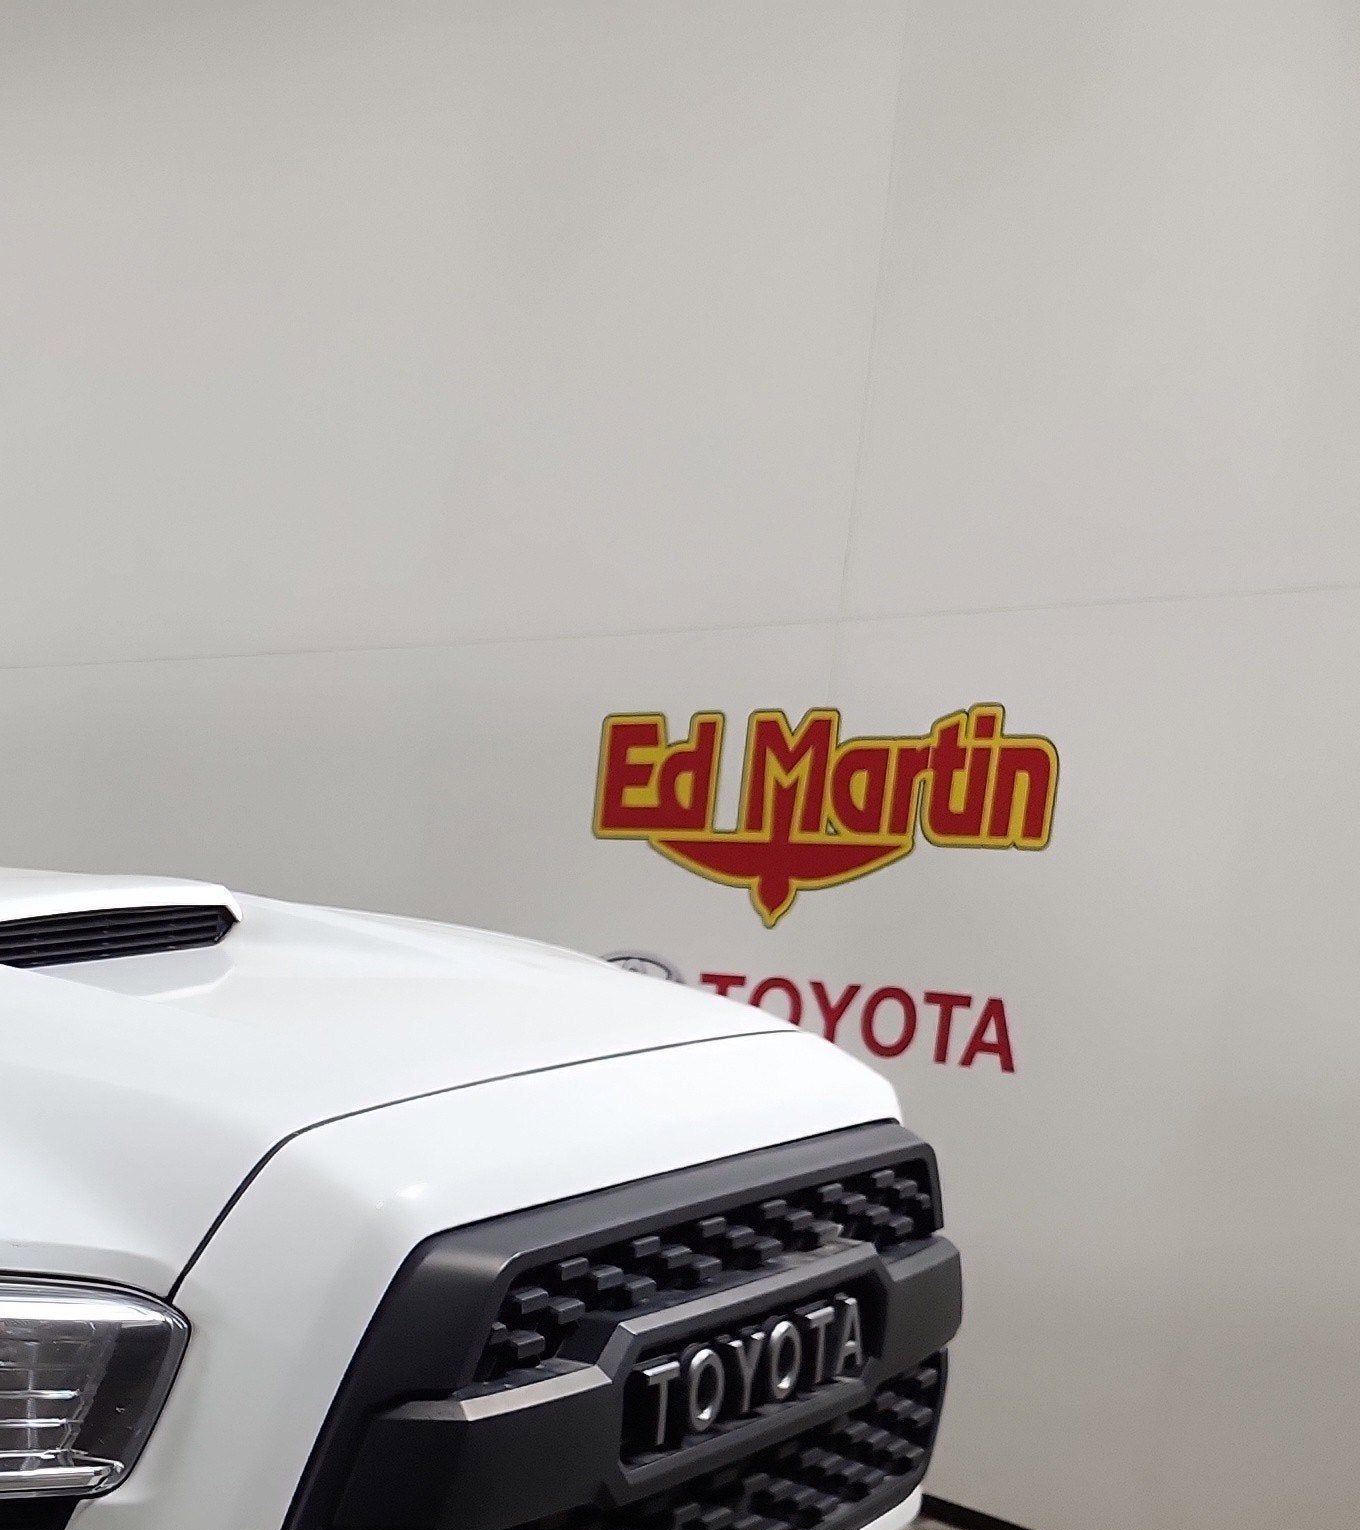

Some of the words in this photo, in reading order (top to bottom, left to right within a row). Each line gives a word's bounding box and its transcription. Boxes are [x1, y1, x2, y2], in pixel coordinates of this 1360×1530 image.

[593, 711, 723, 839] Ed
[744, 704, 1059, 850] Martin
[636, 1293, 864, 1447] TOYOTA
